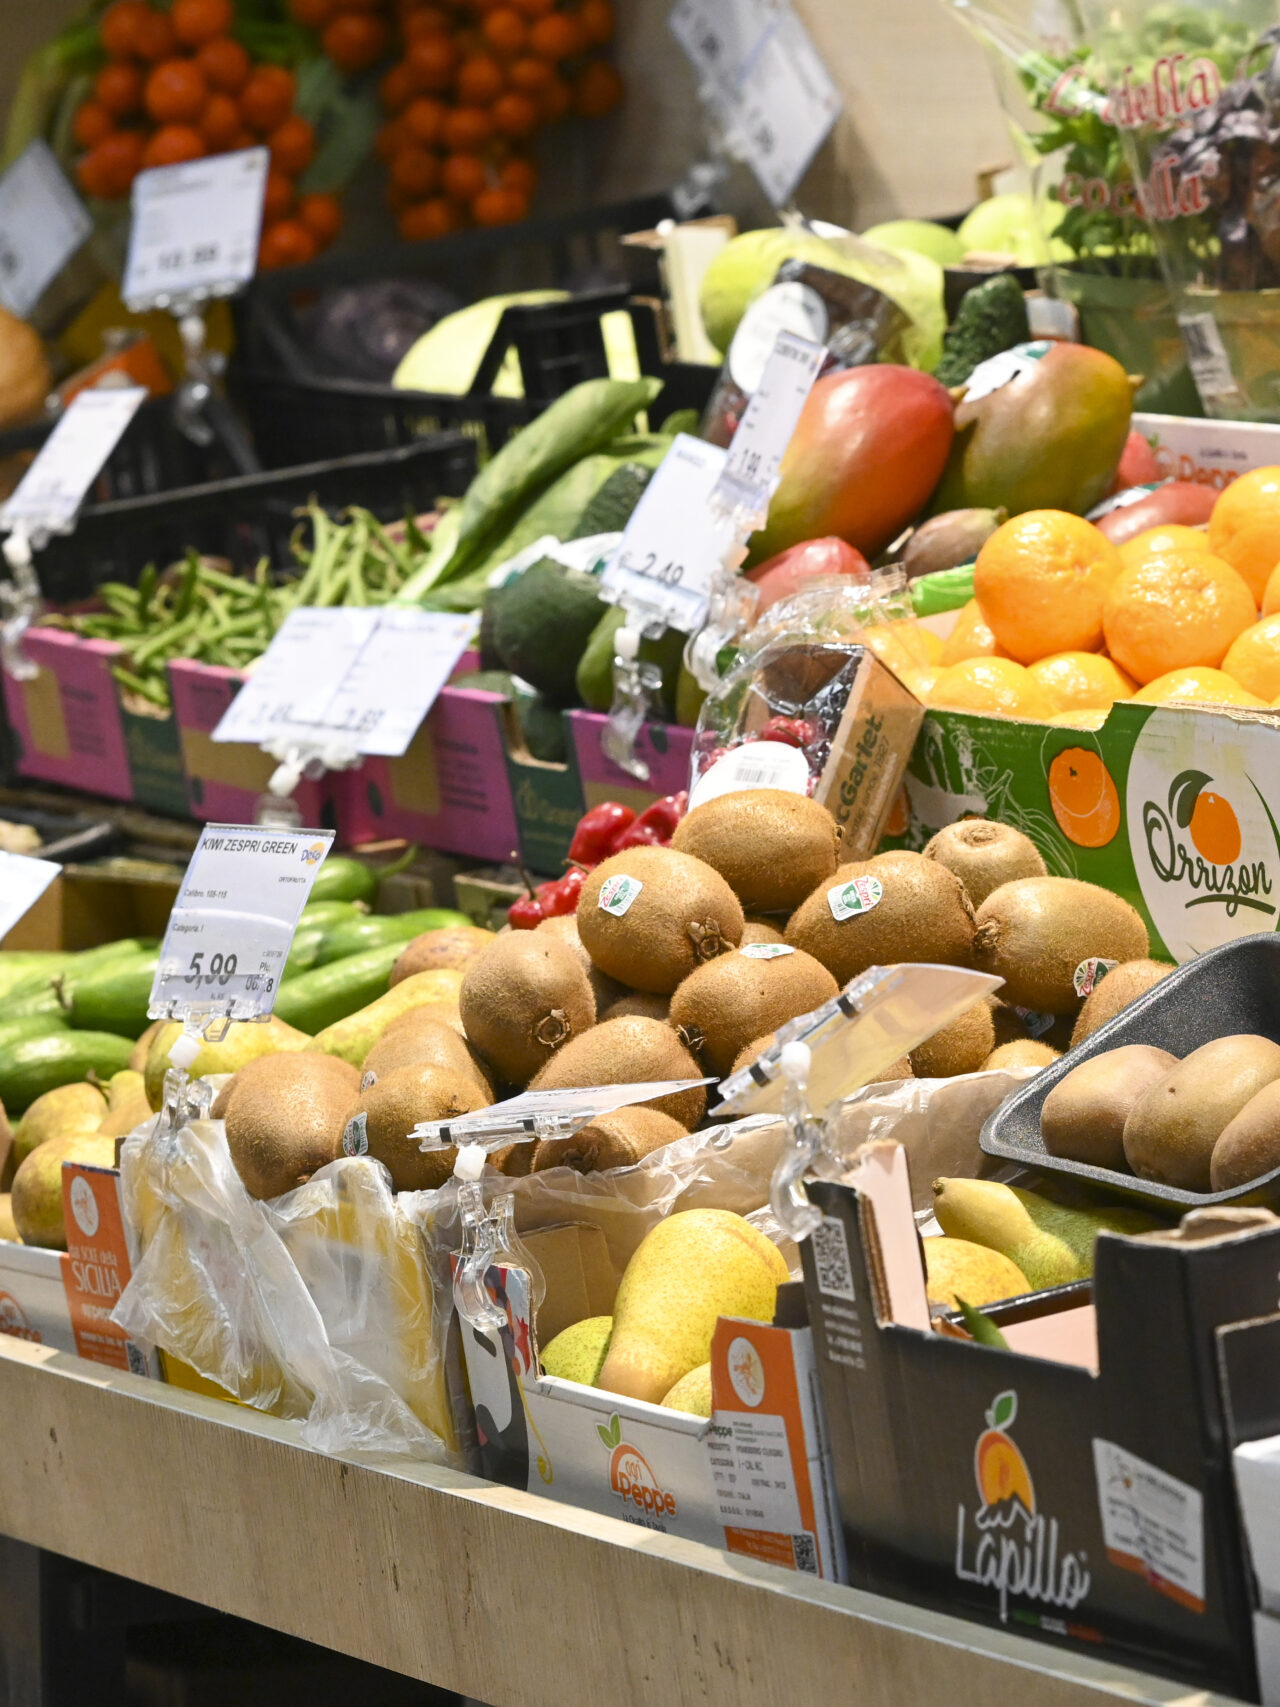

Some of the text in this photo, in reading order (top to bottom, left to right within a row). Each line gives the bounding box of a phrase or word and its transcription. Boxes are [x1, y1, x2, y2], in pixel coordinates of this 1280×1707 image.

[836, 714, 883, 824] cGarlet
[201, 838, 298, 854] KIWI ZESPRI GREEN
[184, 952, 238, 990] 5,99
[72, 1261, 123, 1298] SICILIA
[625, 1460, 642, 1480] agri
[618, 1472, 676, 1518] Peppe
[956, 1503, 1091, 1623] Lapillo
